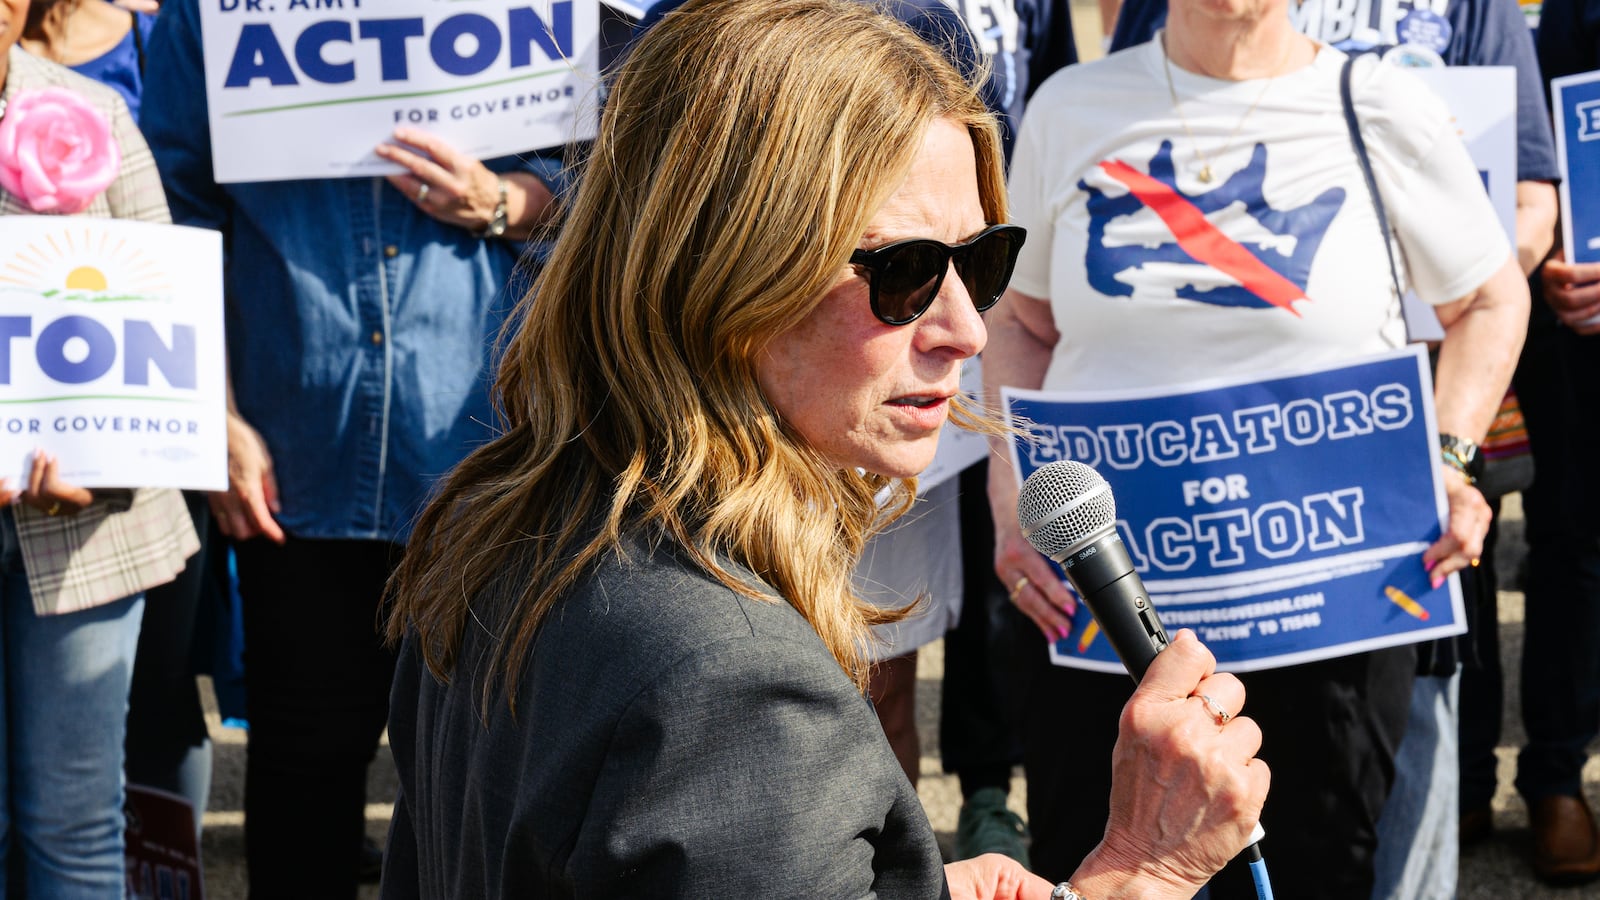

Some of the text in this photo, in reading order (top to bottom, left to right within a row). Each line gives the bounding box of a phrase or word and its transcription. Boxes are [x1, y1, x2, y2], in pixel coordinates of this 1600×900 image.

[223, 1, 574, 88] ACTON
[393, 109, 440, 124] FOR
[451, 86, 575, 119] GOVERNOR
[0, 416, 199, 434] OR GOVERNOR
[1028, 383, 1414, 469] EDUCATORS
[1183, 473, 1250, 507] FOR
[1115, 486, 1365, 573] CTON
[1079, 546, 1097, 560] SM58
[1258, 619, 1279, 636] TO
